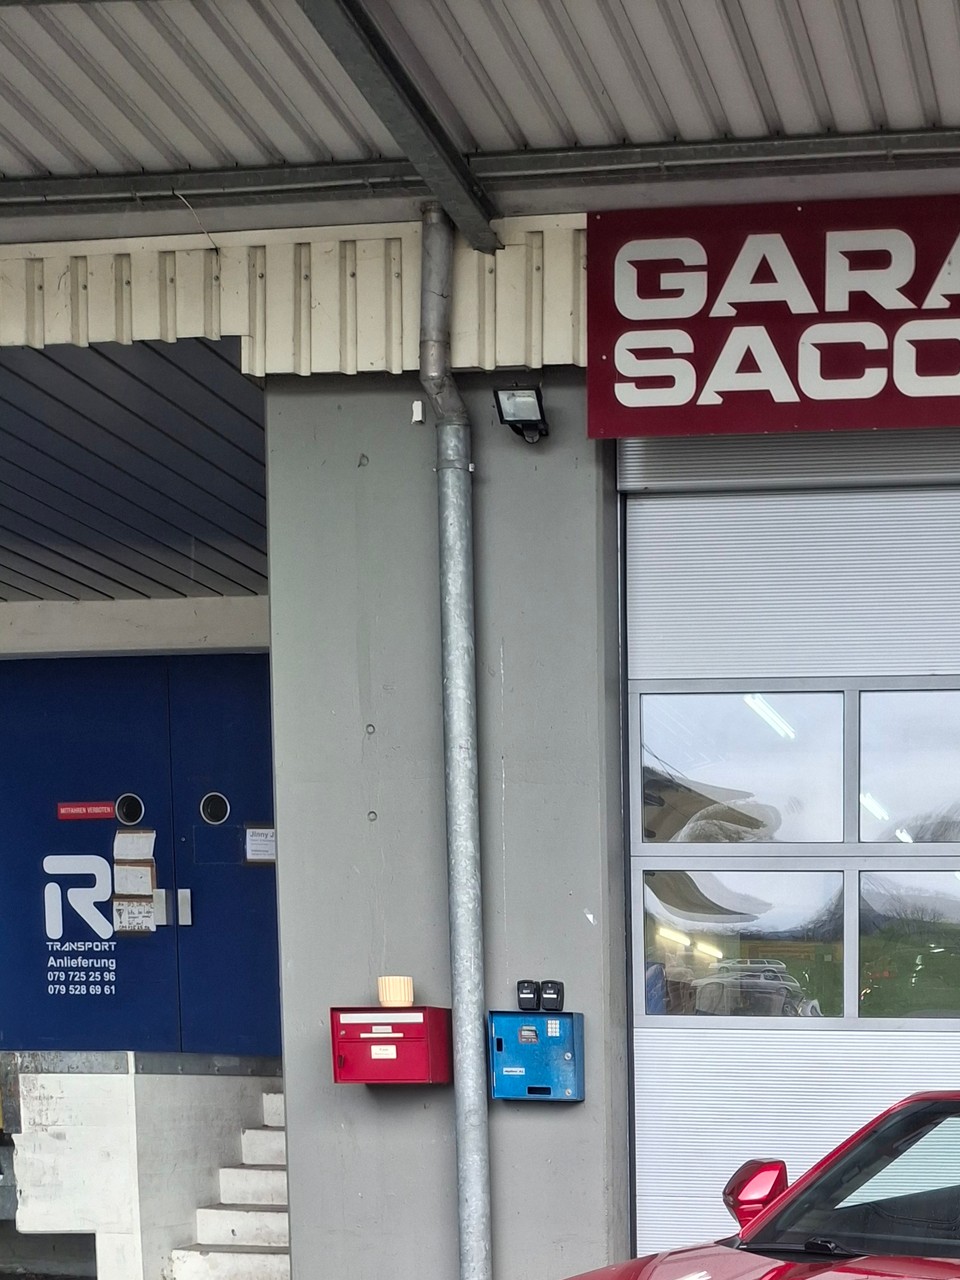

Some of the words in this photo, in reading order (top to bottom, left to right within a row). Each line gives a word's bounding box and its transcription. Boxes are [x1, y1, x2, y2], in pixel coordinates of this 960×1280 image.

[46, 942, 117, 951] TRANSPORT
[47, 956, 116, 970] Anlieferung
[47, 971, 66, 982] 079
[68, 971, 87, 982] 725
[88, 971, 102, 982] 25
[103, 971, 116, 982] 96
[47, 985, 66, 995] 079
[68, 985, 87, 995] 528
[89, 985, 102, 995] 69
[104, 985, 115, 995] 61
